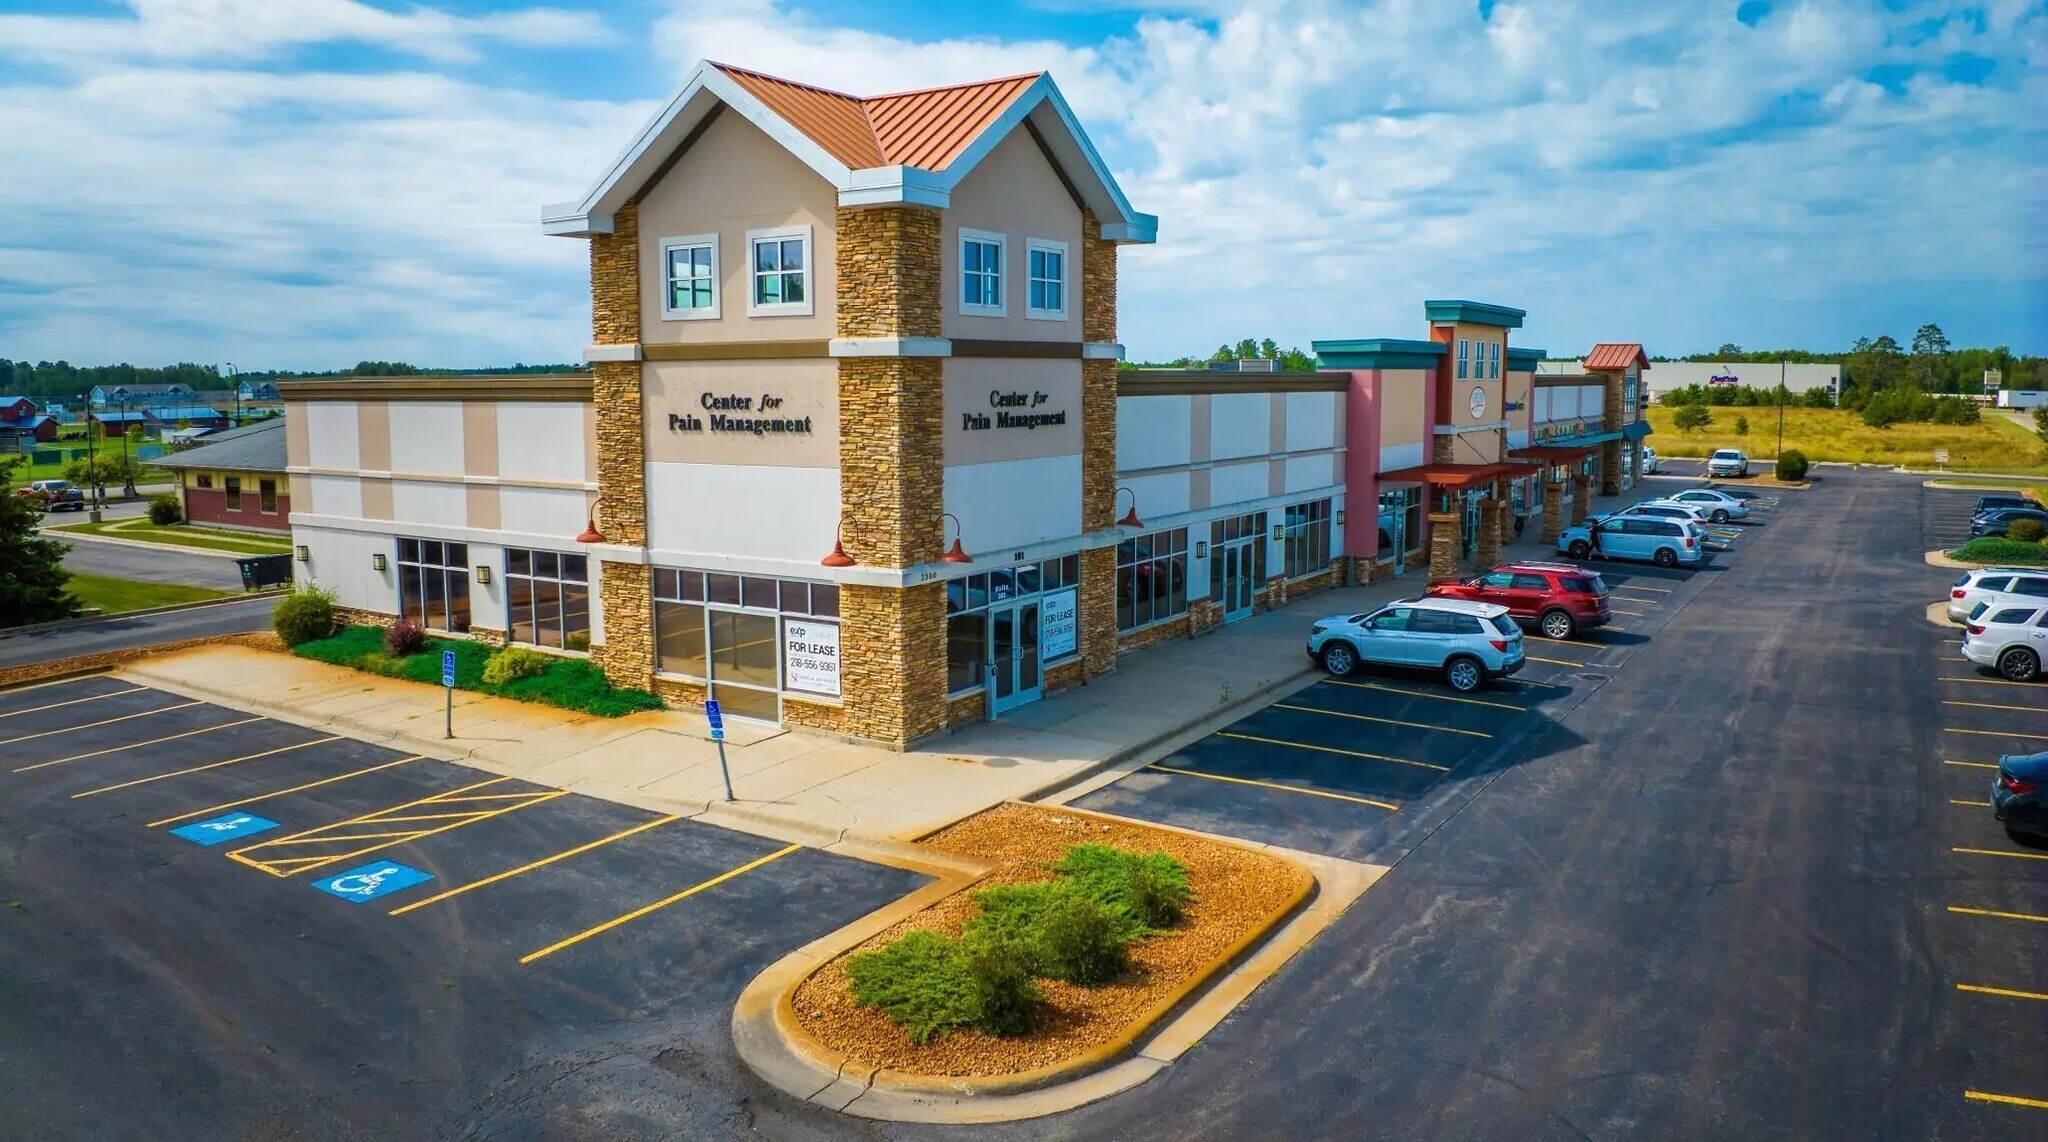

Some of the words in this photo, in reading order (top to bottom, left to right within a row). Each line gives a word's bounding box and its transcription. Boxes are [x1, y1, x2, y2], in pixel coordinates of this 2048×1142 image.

[700, 392, 752, 410] Center
[757, 393, 783, 412] for
[989, 390, 1028, 408] Center
[1030, 390, 1048, 408] for
[668, 413, 702, 431] Pain
[710, 414, 812, 435] Management
[962, 412, 991, 431] Pain
[996, 409, 1066, 430] Management
[1057, 608, 1074, 621] LEASE
[789, 627, 806, 638] exp
[789, 642, 806, 652] FOR
[808, 643, 835, 656] LEASE
